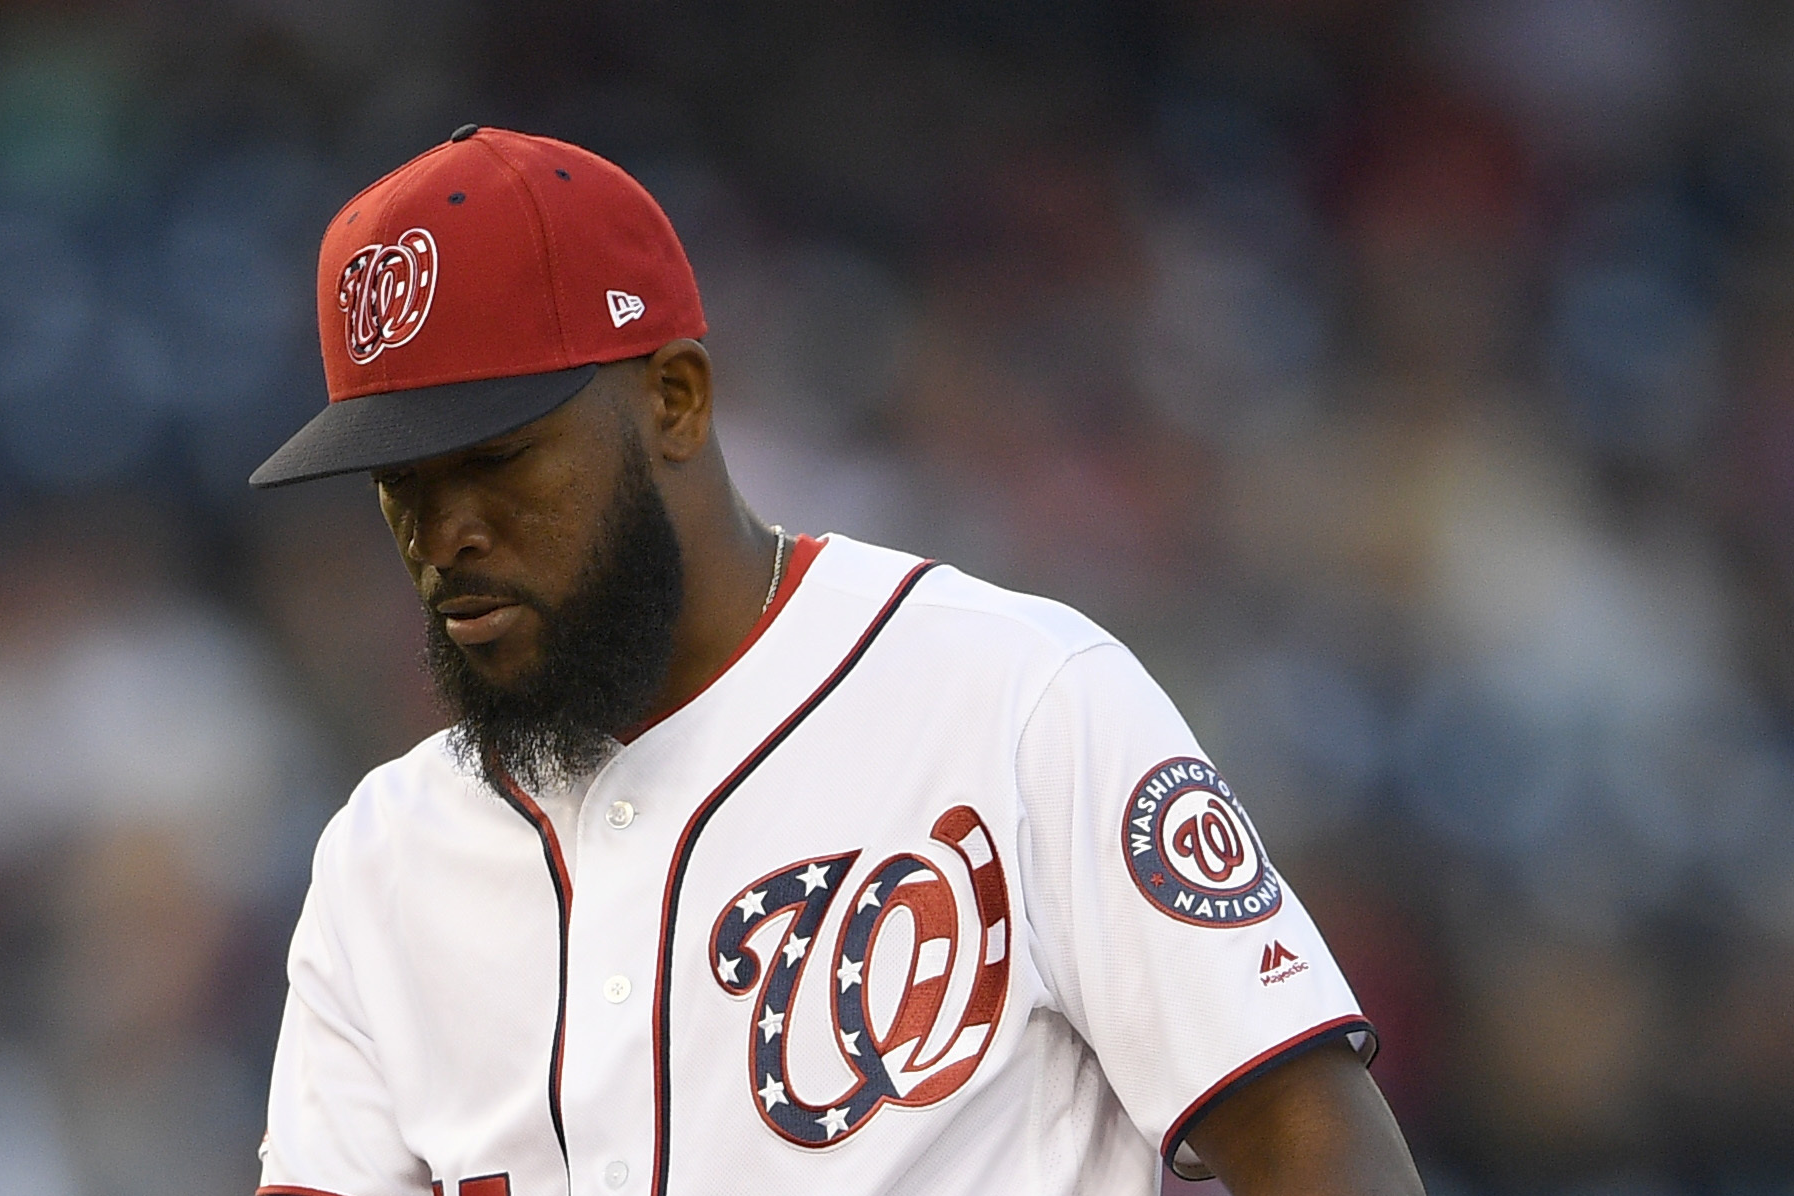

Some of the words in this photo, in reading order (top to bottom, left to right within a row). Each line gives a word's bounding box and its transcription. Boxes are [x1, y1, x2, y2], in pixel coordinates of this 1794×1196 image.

[338, 227, 439, 365] W
[1172, 798, 1245, 882] W
[1173, 864, 1280, 918] NATIONAL
[708, 804, 1012, 1152] W
[1260, 961, 1309, 987] Majestic
